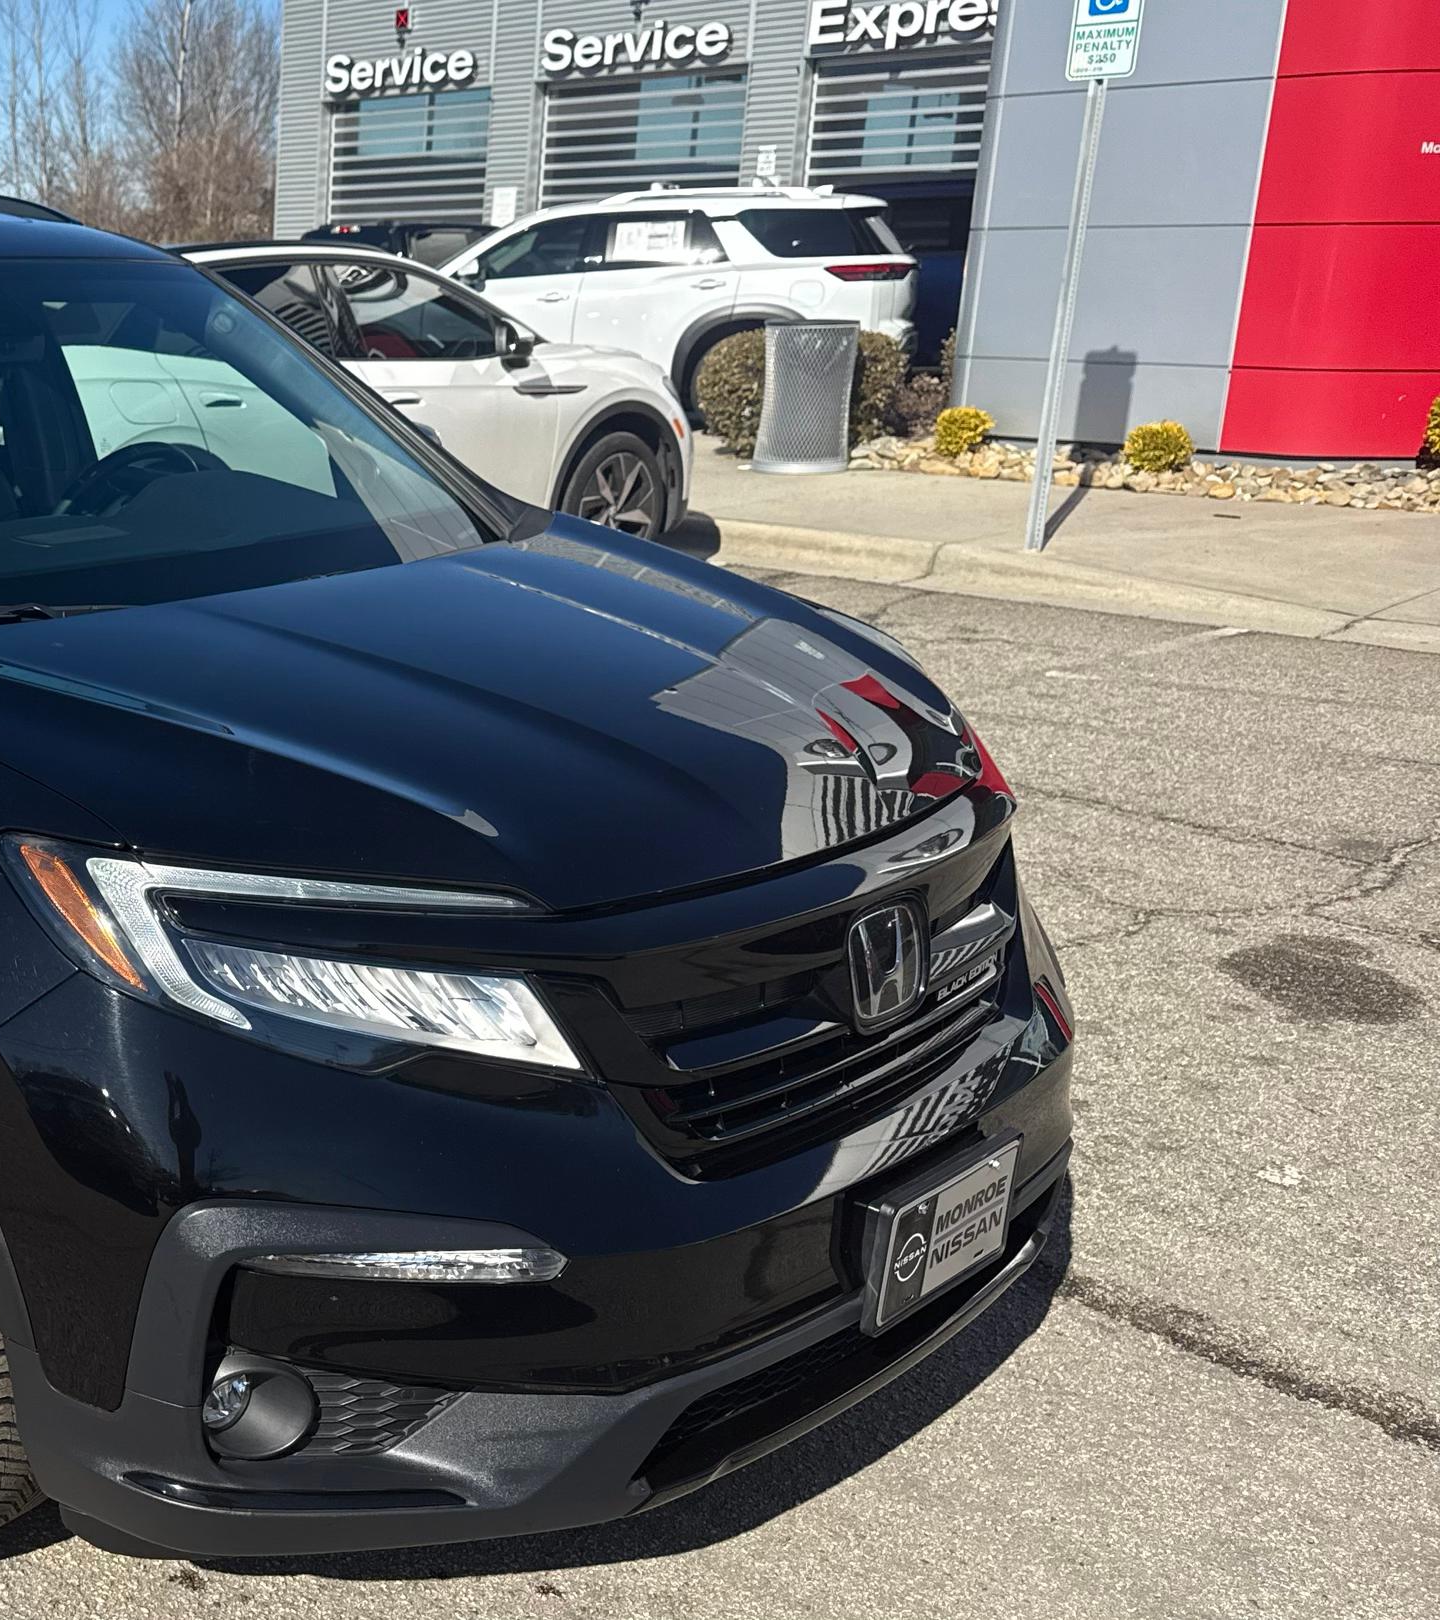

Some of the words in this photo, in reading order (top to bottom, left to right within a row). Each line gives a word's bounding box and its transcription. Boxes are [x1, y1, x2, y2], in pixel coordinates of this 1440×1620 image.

[540, 19, 730, 72] Service
[808, 0, 998, 50] Expre
[1075, 39, 1132, 53] PENALTY
[1076, 26, 1135, 41] MAXIMUM
[324, 46, 474, 93] Service
[937, 972, 968, 1001] BLACK
[935, 1175, 1009, 1235] MONROE
[893, 1244, 928, 1271] NISSAN
[929, 1206, 1004, 1269] NISSAN
